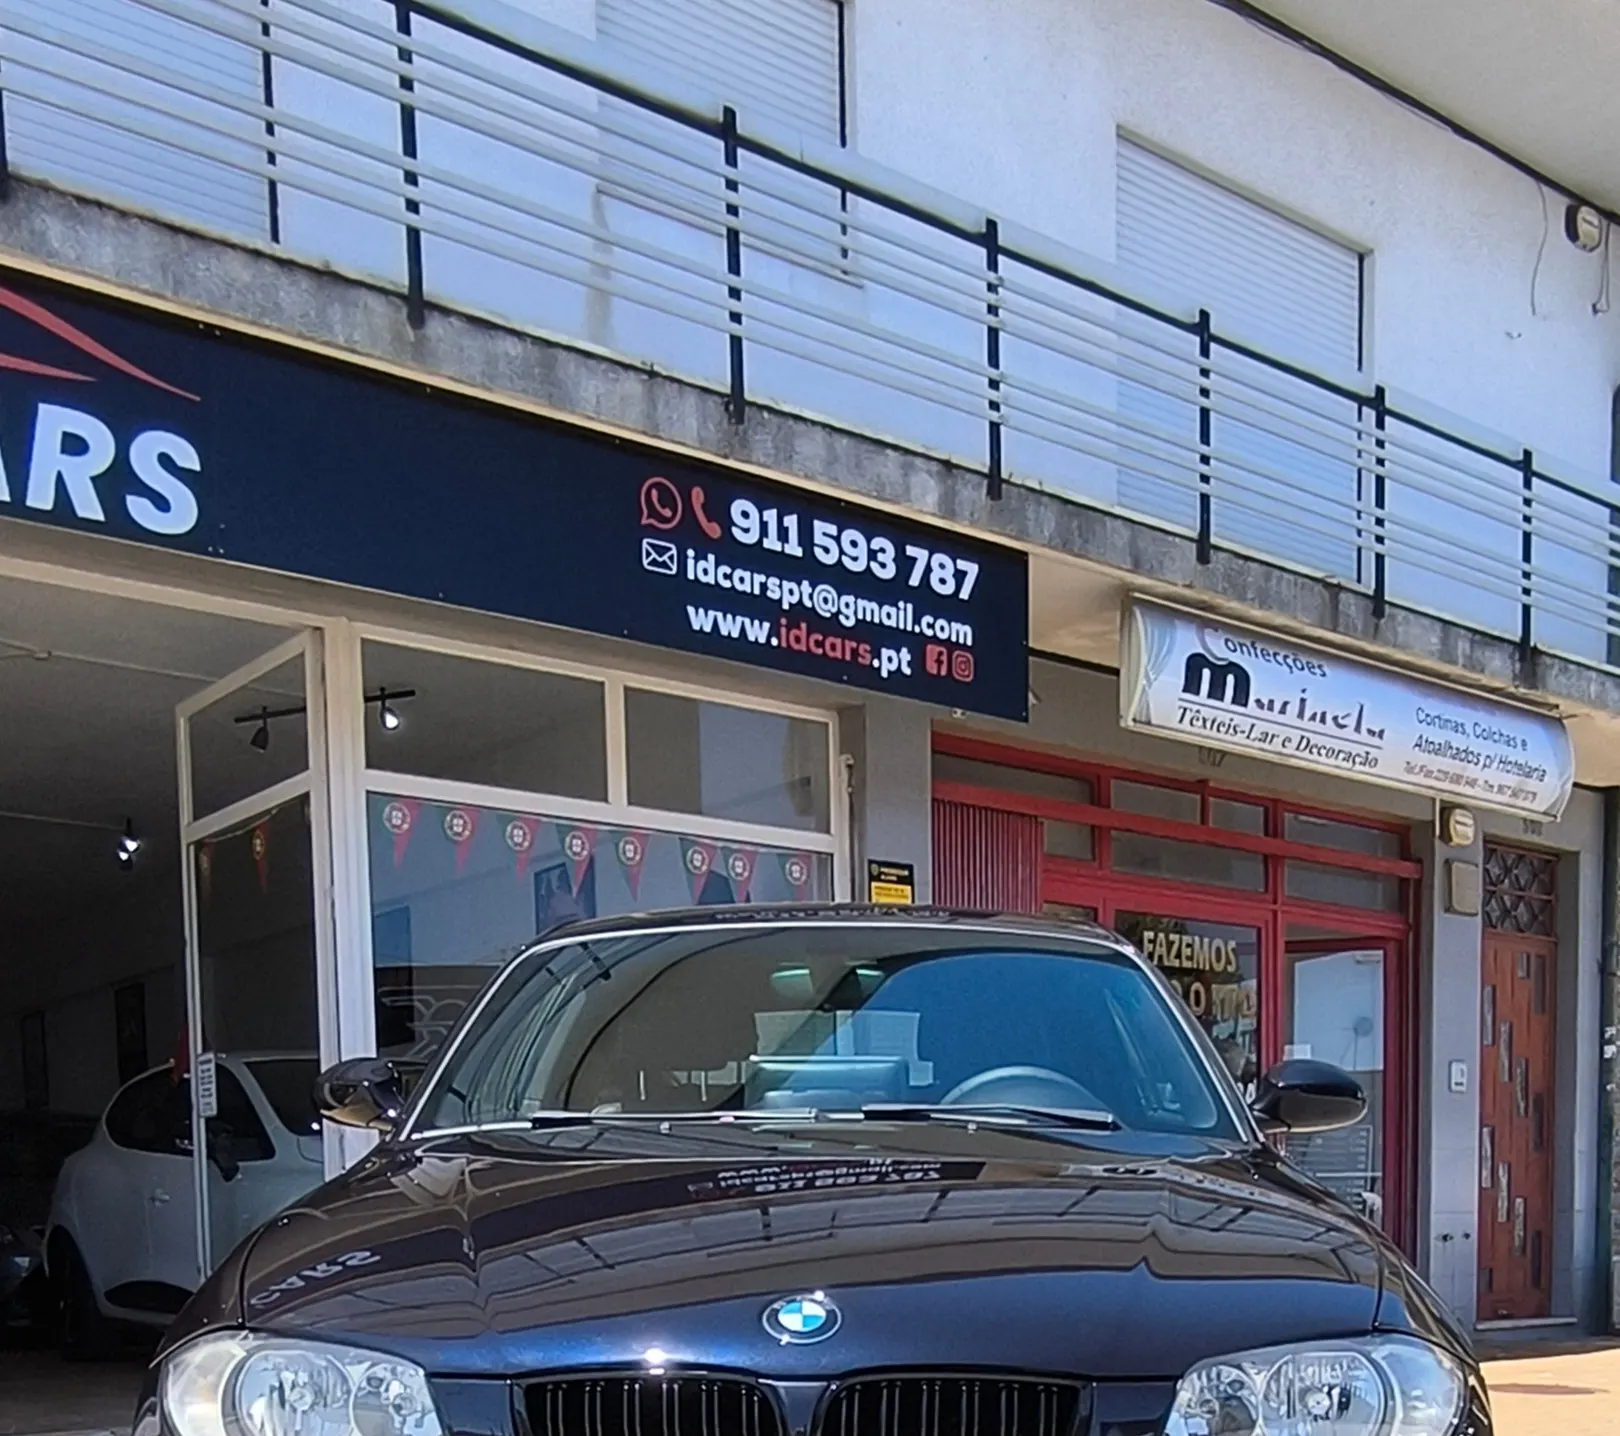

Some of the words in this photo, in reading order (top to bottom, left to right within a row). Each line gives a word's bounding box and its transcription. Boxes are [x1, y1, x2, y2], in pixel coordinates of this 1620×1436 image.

[0, 402, 202, 535] RS
[729, 498, 803, 558] 911
[812, 519, 897, 580] 593
[905, 543, 980, 601] 787
[686, 548, 974, 647] idcarspt@gmail.com
[686, 604, 913, 679] www.idcars.pt
[1281, 732, 1292, 749] e
[1294, 734, 1380, 770] Decoração
[1472, 721, 1518, 750] Colchas
[1496, 752, 1548, 783] Hotelaria
[1143, 930, 1237, 973] FAZEMOS
